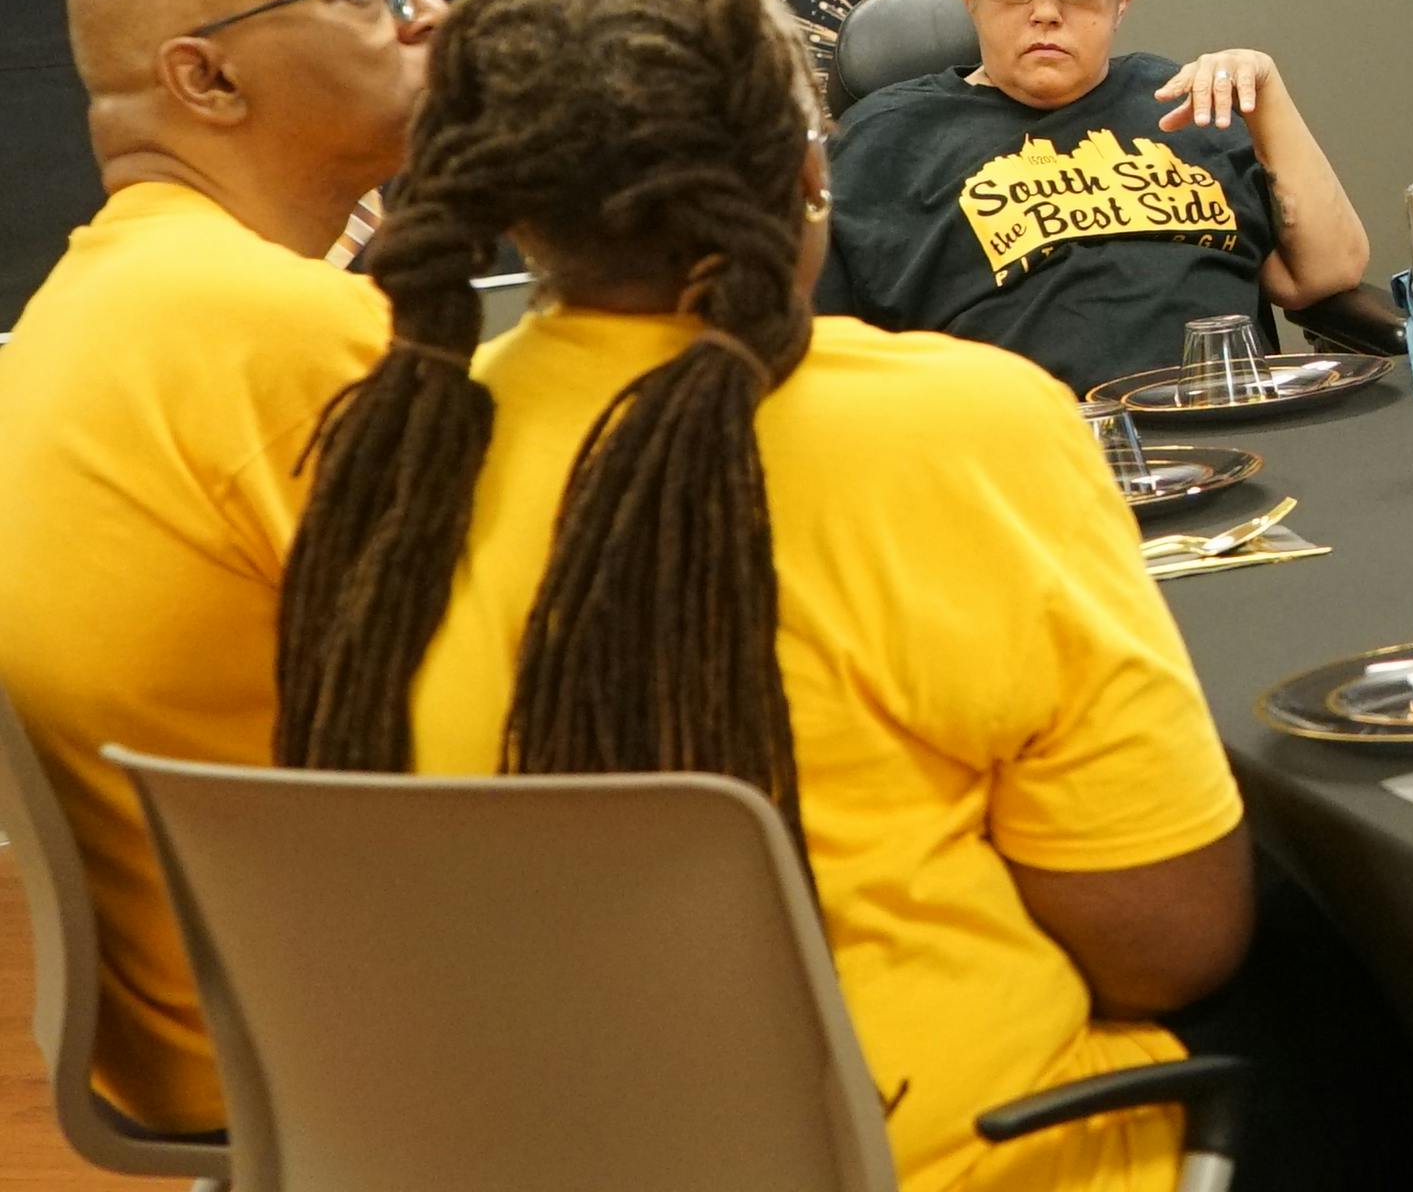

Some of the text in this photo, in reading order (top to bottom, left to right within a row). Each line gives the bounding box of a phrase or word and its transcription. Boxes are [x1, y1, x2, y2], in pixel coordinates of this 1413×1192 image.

[969, 160, 1215, 217] South Side
[990, 190, 1230, 256] the Best Side
